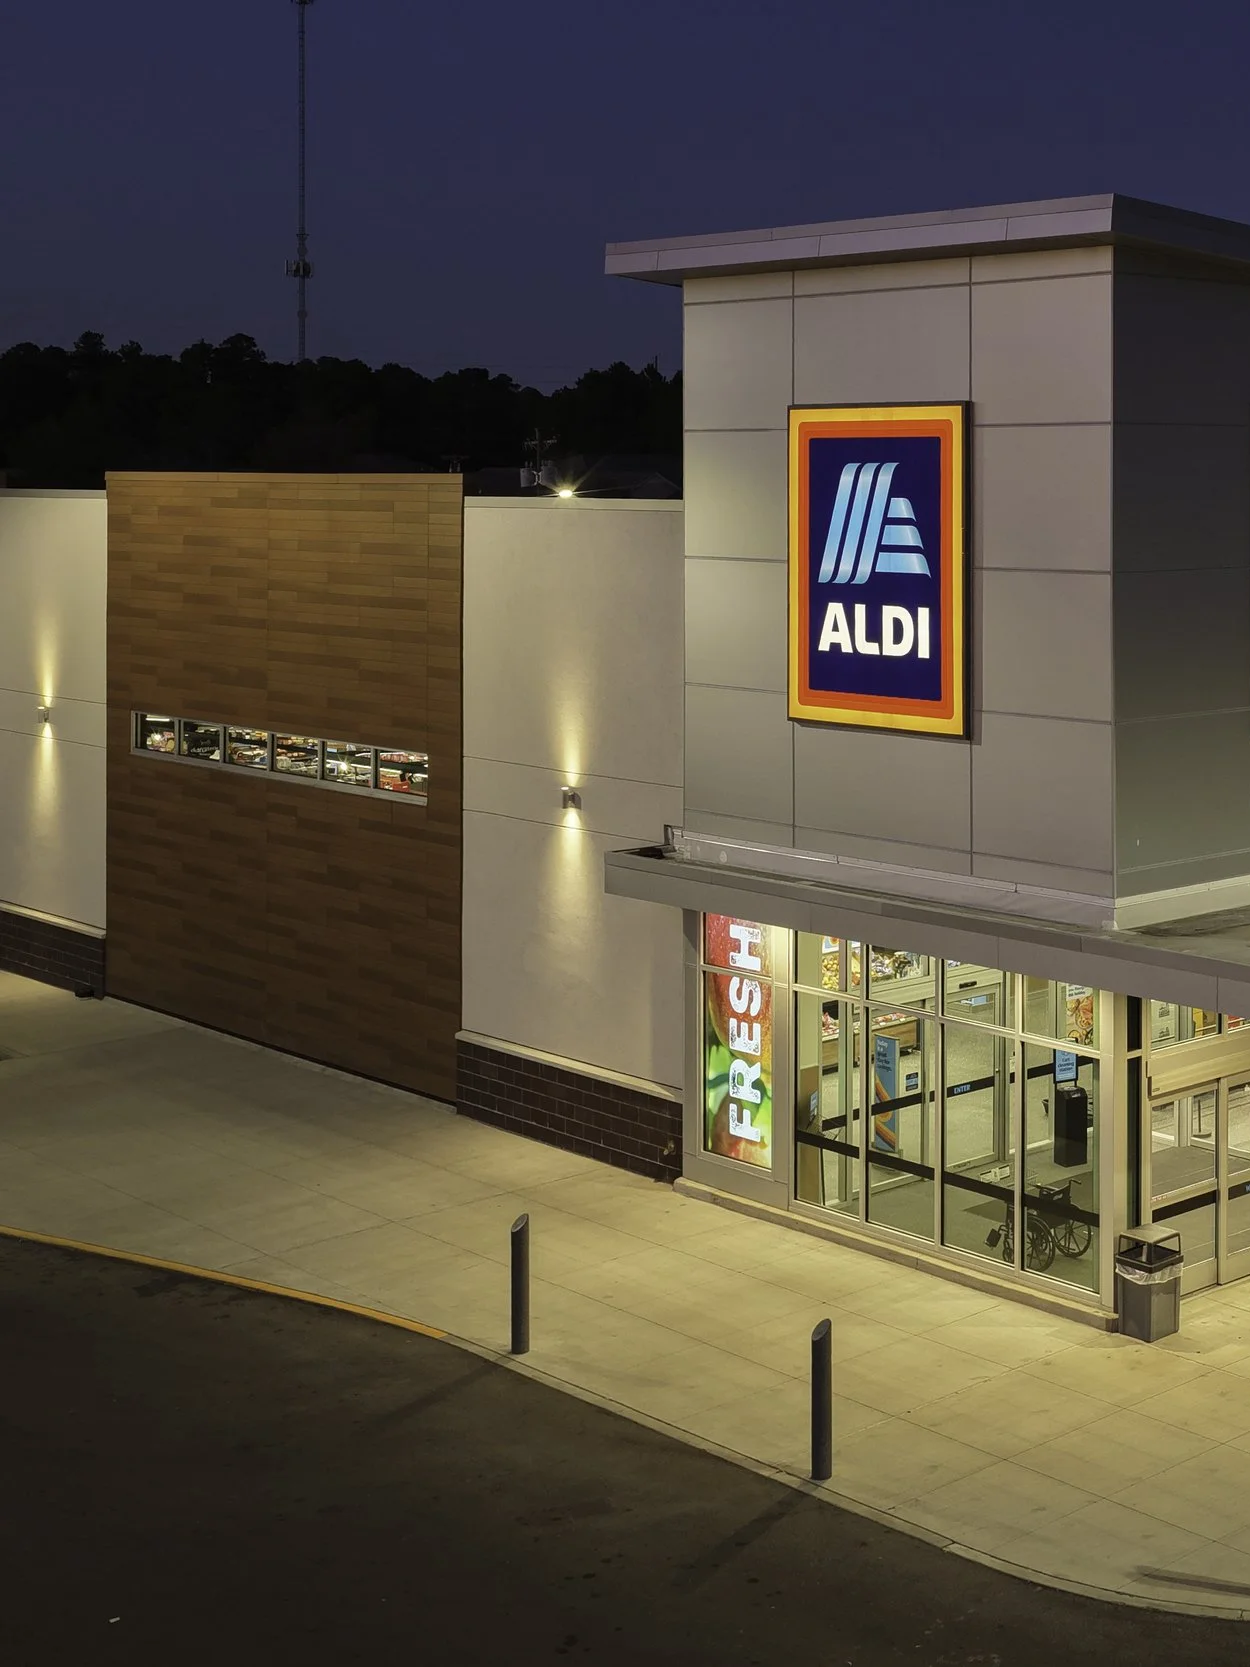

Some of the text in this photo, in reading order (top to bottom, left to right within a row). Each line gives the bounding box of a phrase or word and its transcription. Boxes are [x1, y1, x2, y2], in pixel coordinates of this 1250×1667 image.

[817, 602, 931, 659] ALDI
[728, 924, 761, 1142] FRESH
[953, 1084, 971, 1094] ENTER
